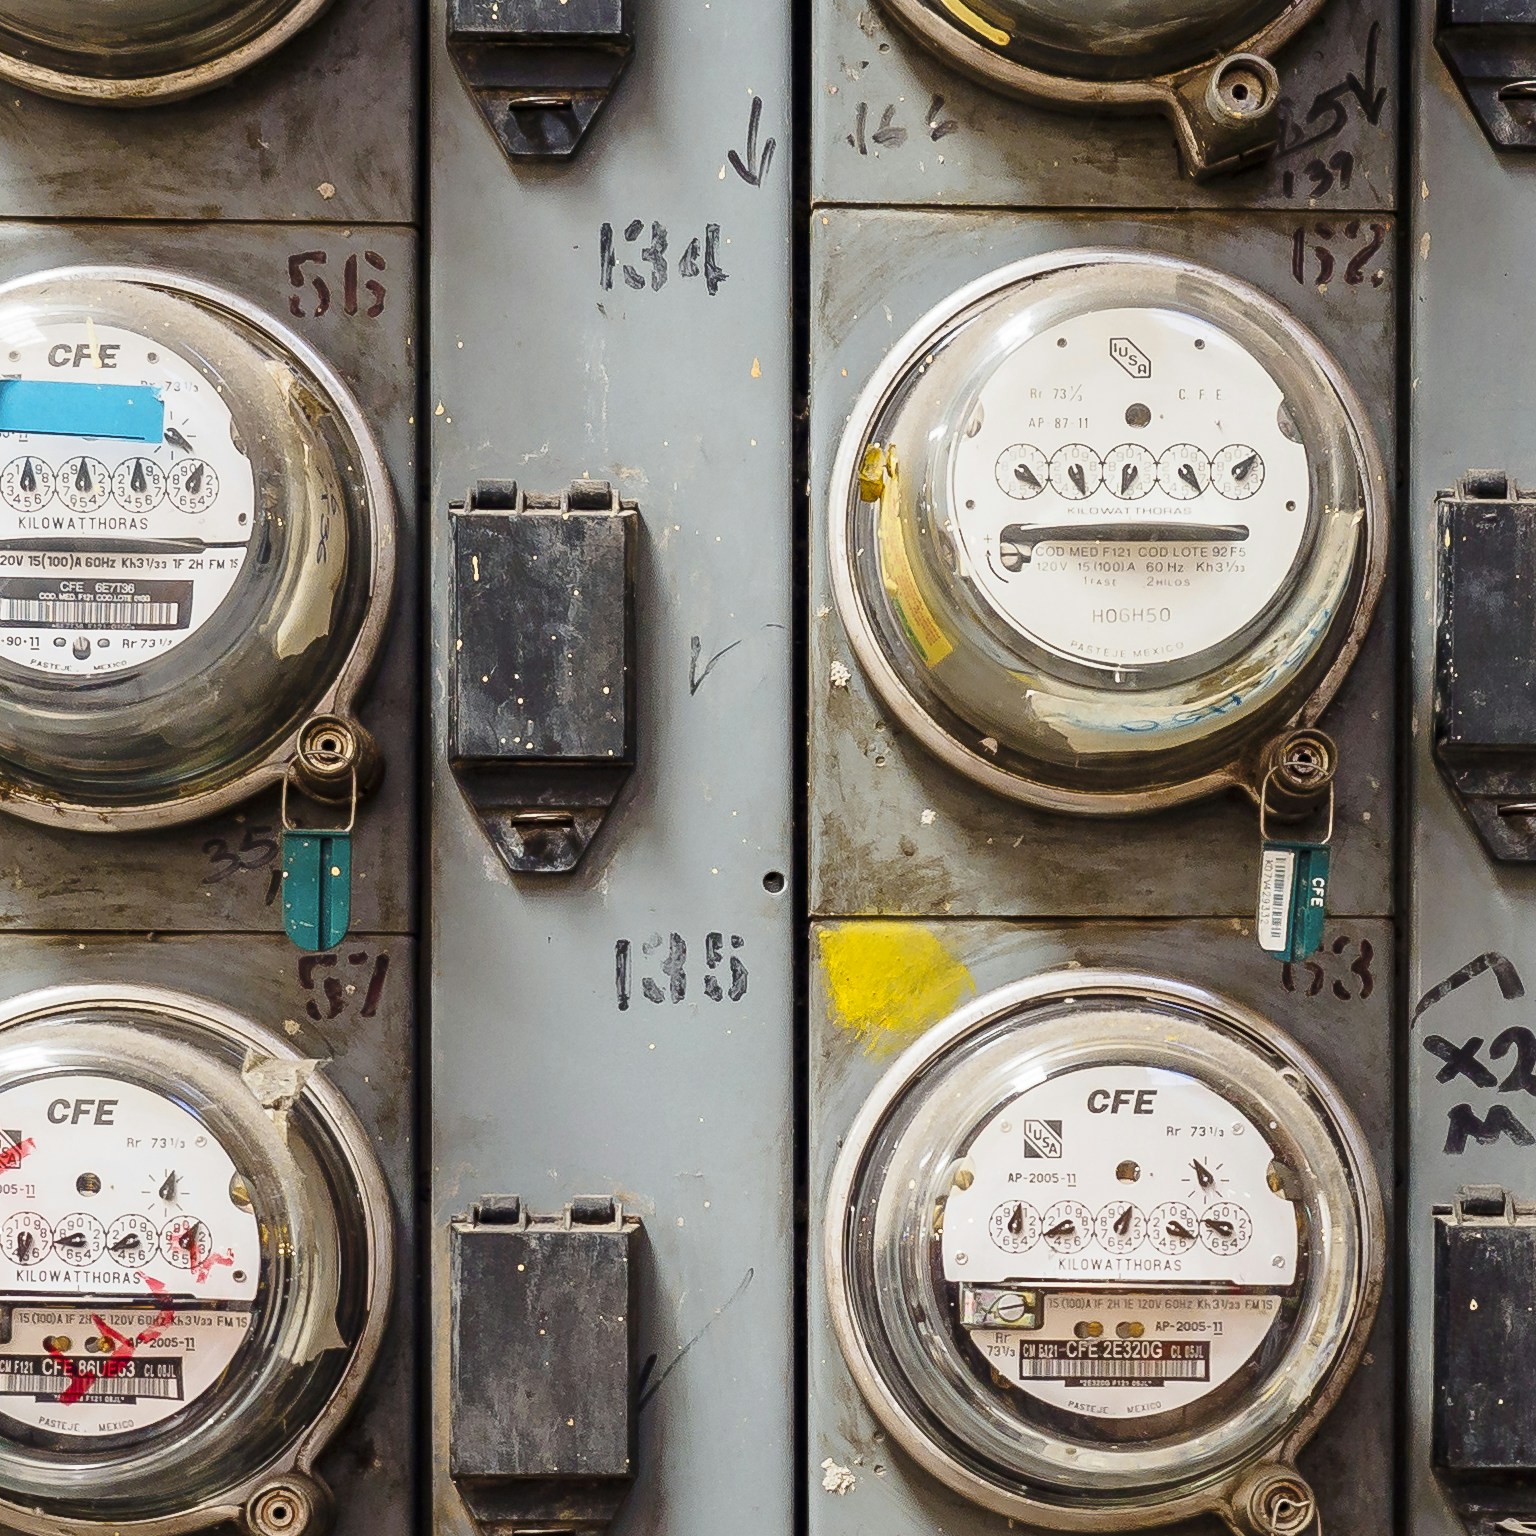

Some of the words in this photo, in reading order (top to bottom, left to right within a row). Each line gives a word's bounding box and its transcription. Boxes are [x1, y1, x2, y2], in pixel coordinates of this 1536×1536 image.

[599, 220, 730, 296] 134
[287, 250, 387, 319] 56
[48, 343, 121, 369] CFE
[1112, 342, 1147, 375] IUSA
[18, 517, 149, 530] KILOWATTHORAS
[1067, 507, 1192, 515] KILOWATTHORAS
[85, 556, 116, 569] 60Hz
[60, 581, 84, 593] CFE
[1311, 876, 1324, 908] CFE
[298, 951, 389, 1021] 57
[47, 1098, 118, 1126] CFE
[1087, 1089, 1157, 1115] CFE
[1027, 1122, 1059, 1156] IUSA
[16, 1270, 141, 1284] KILOWATTHORAS
[1058, 1259, 1182, 1271] KILOWATTHORAS
[1066, 1341, 1099, 1358] CFE
[1103, 1342, 1163, 1358] 2E320G
[41, 1359, 73, 1376] CFE
